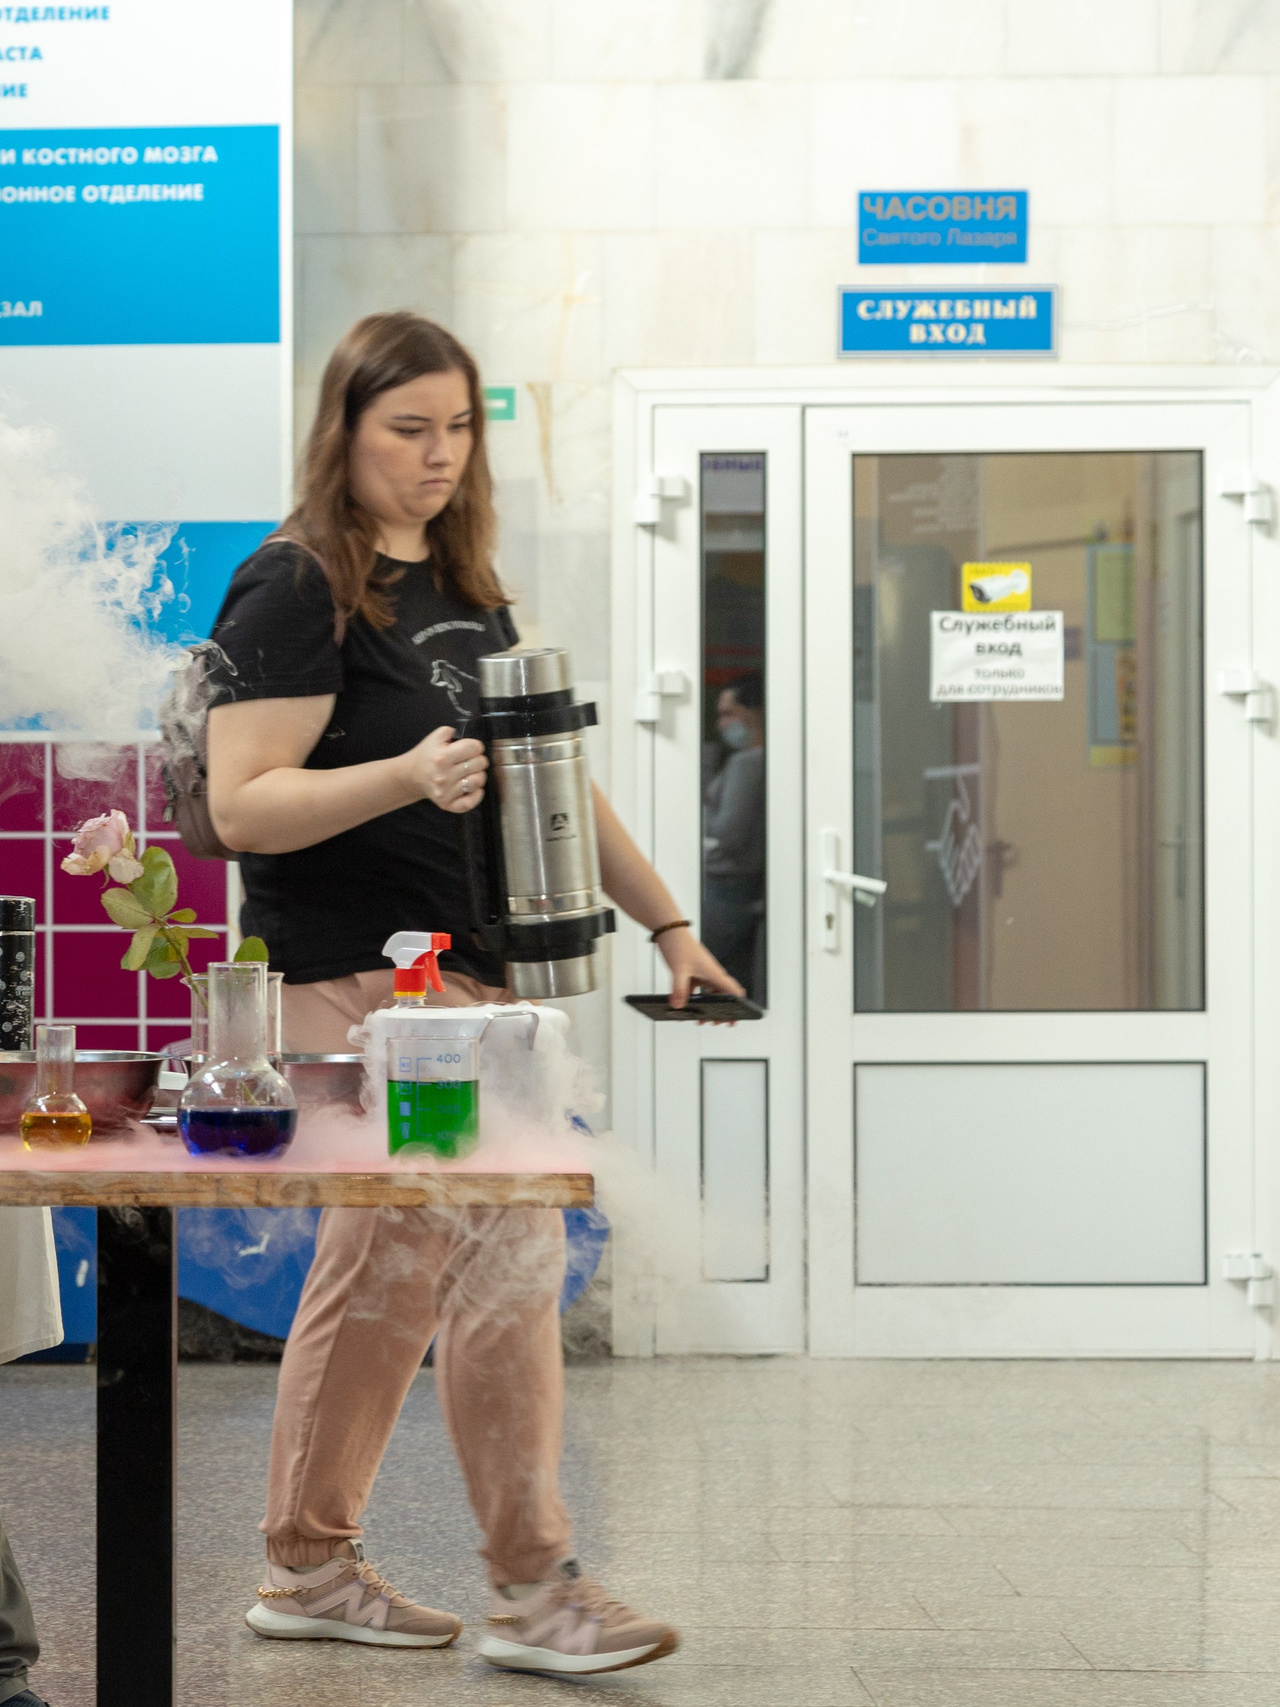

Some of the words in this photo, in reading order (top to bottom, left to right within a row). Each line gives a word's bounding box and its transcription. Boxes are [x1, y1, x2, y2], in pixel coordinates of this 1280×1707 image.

[22, 147, 139, 165] КОСТНОГО
[143, 145, 219, 163] МОЗГА
[81, 183, 204, 204] ОТДЕЛЕНИЕ
[863, 196, 1017, 221] ЧАСОВНЯ
[862, 228, 942, 248] Святого
[946, 227, 1018, 248] Лазаря
[856, 296, 1038, 320] СЛУЖЕБНЫЙ
[908, 322, 987, 346] ВХОД
[939, 615, 1057, 637] Служебный
[976, 643, 1023, 656] вход
[975, 668, 1025, 679] только
[436, 1053, 461, 1064] 400
